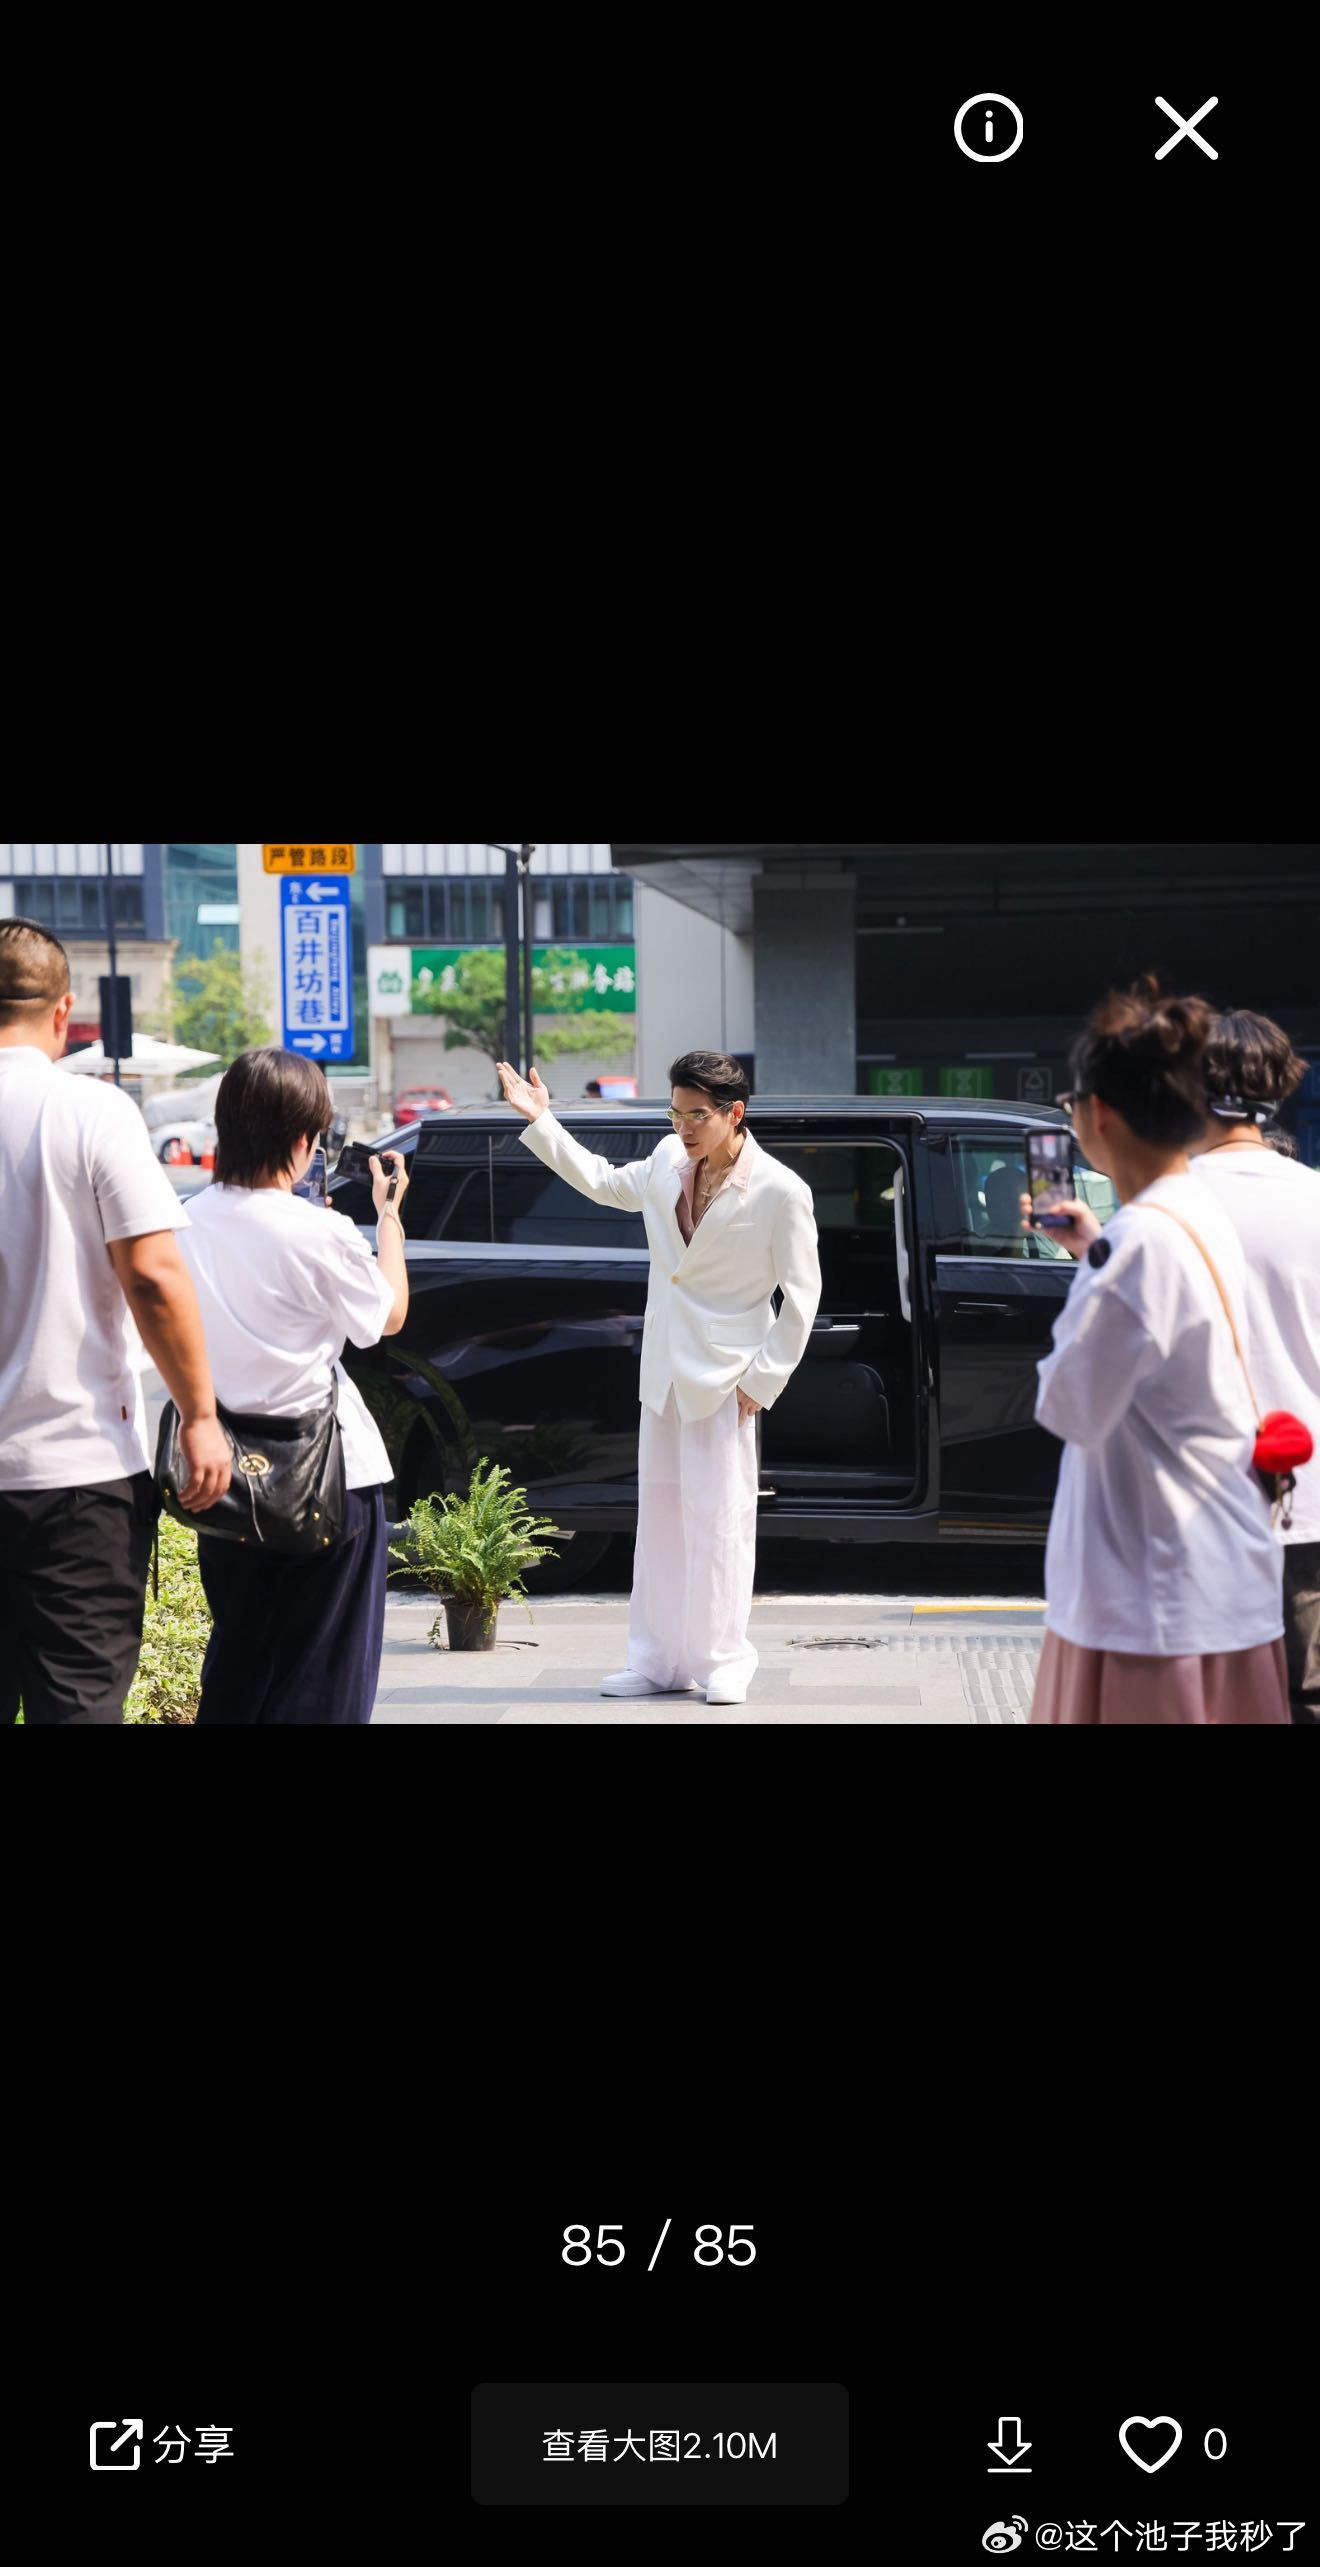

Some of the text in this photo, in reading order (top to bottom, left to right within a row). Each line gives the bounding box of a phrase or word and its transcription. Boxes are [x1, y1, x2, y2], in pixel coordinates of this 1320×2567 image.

[270, 847, 348, 868] 严管路段
[294, 910, 323, 1024] 百井坊巷
